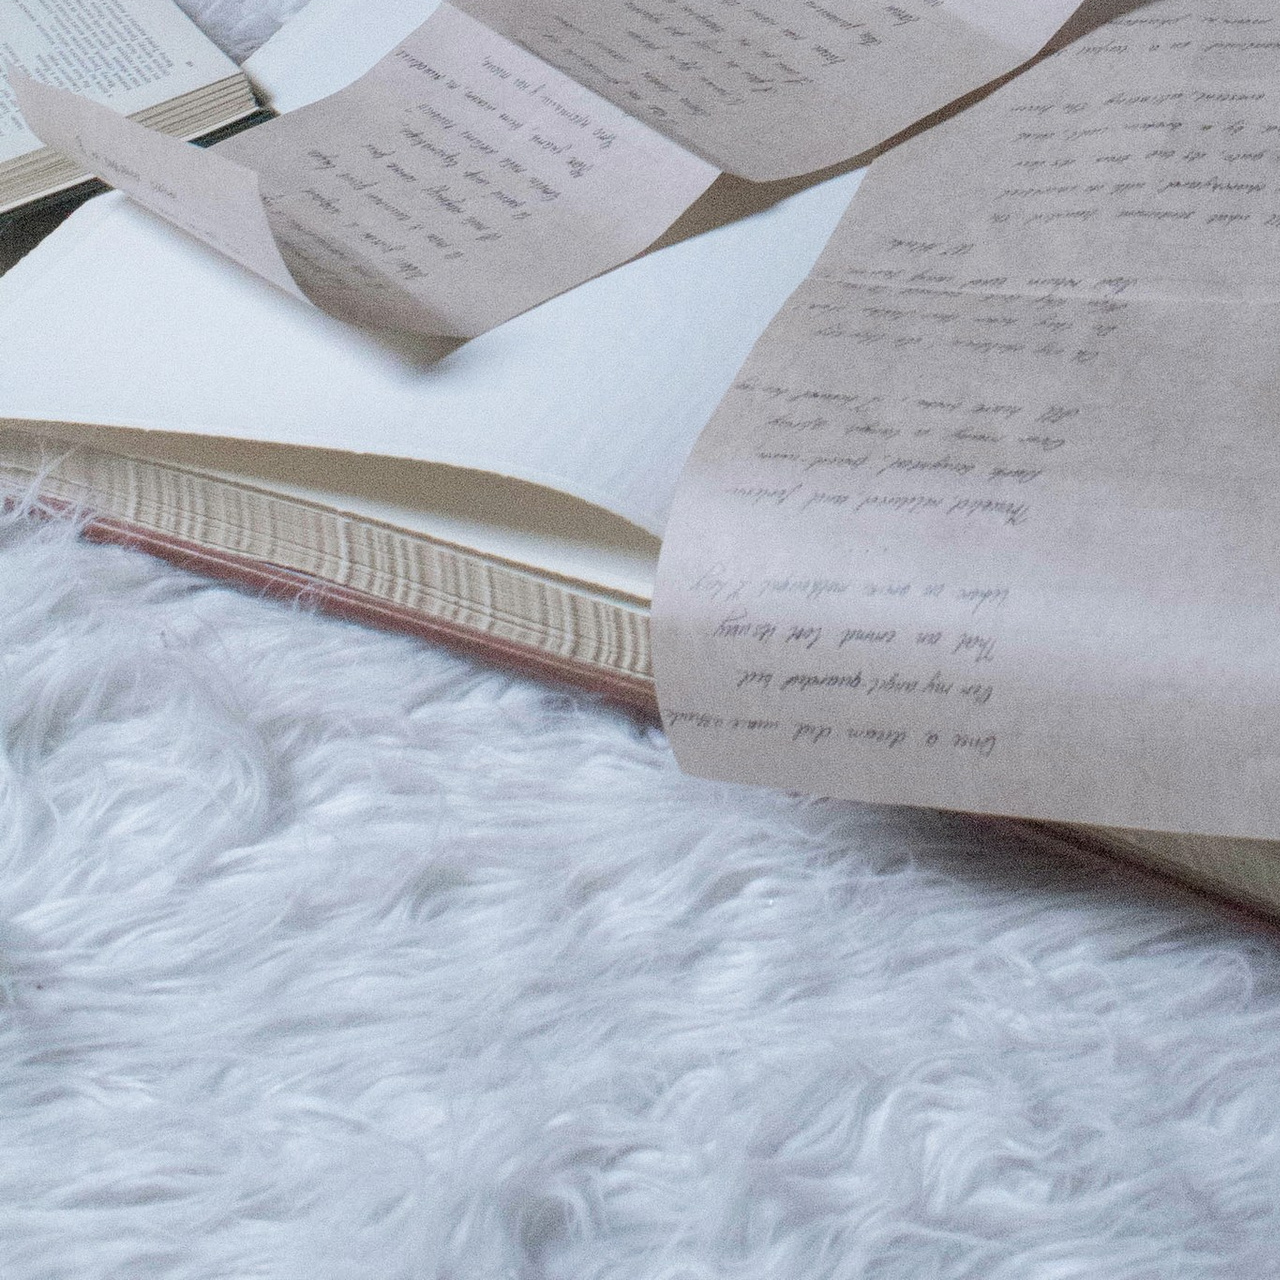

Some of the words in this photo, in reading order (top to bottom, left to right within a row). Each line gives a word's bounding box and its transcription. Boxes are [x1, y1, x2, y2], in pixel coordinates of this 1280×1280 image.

[915, 631, 942, 648] an
[951, 632, 998, 664] That
[791, 723, 832, 744] did
[846, 728, 906, 749] dream
[924, 731, 939, 748] a
